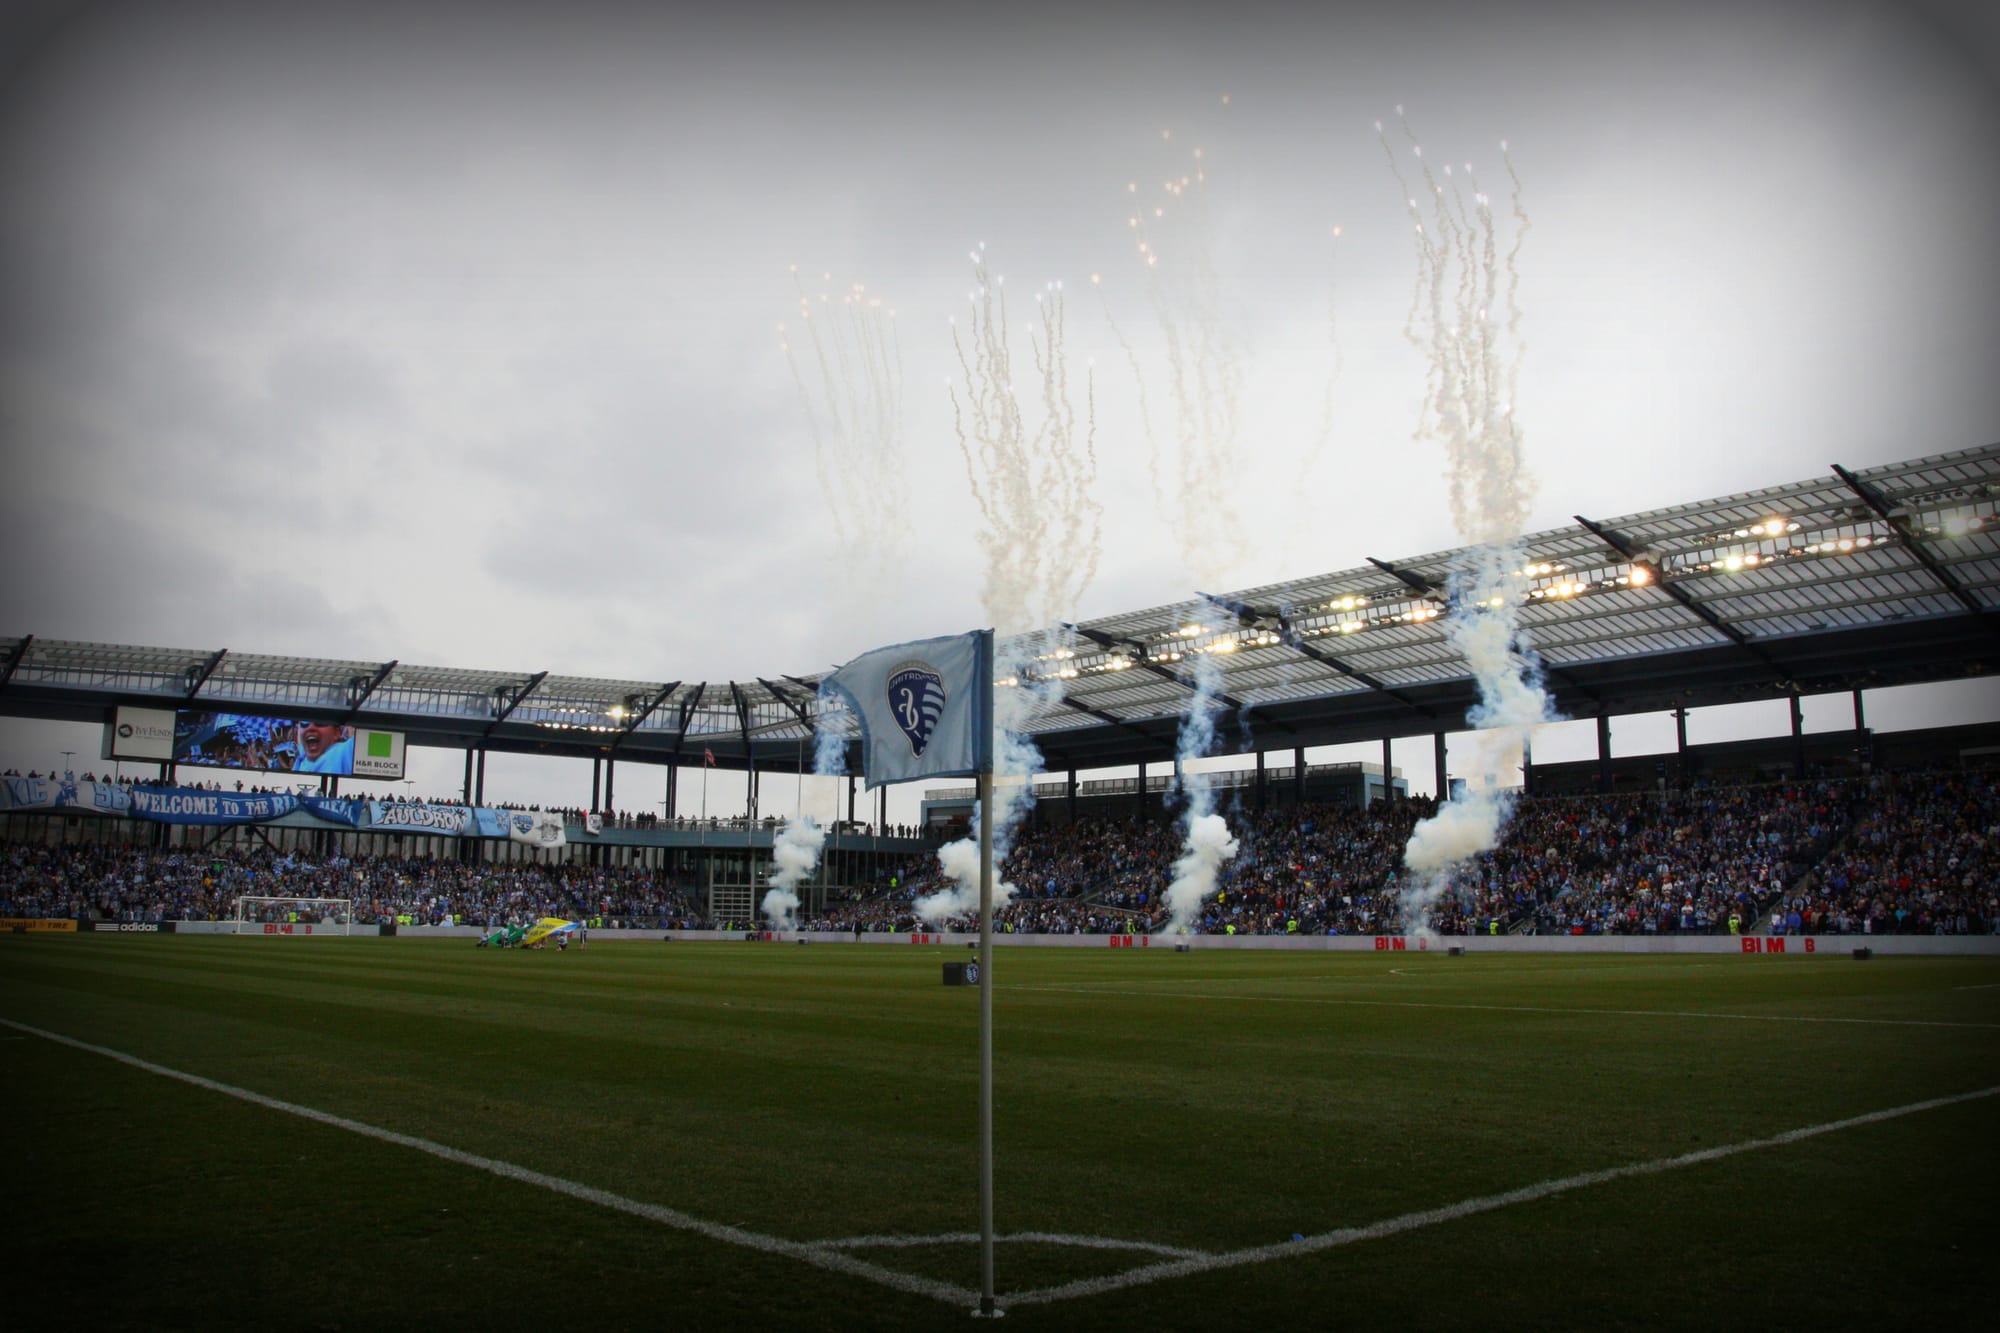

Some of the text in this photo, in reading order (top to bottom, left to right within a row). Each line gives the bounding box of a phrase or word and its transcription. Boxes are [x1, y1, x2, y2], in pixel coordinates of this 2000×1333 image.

[374, 761, 399, 769] BLOCK
[133, 790, 218, 816] WELCOME
[222, 800, 240, 816] TO
[245, 801, 270, 816] THE
[120, 922, 158, 932] adidas
